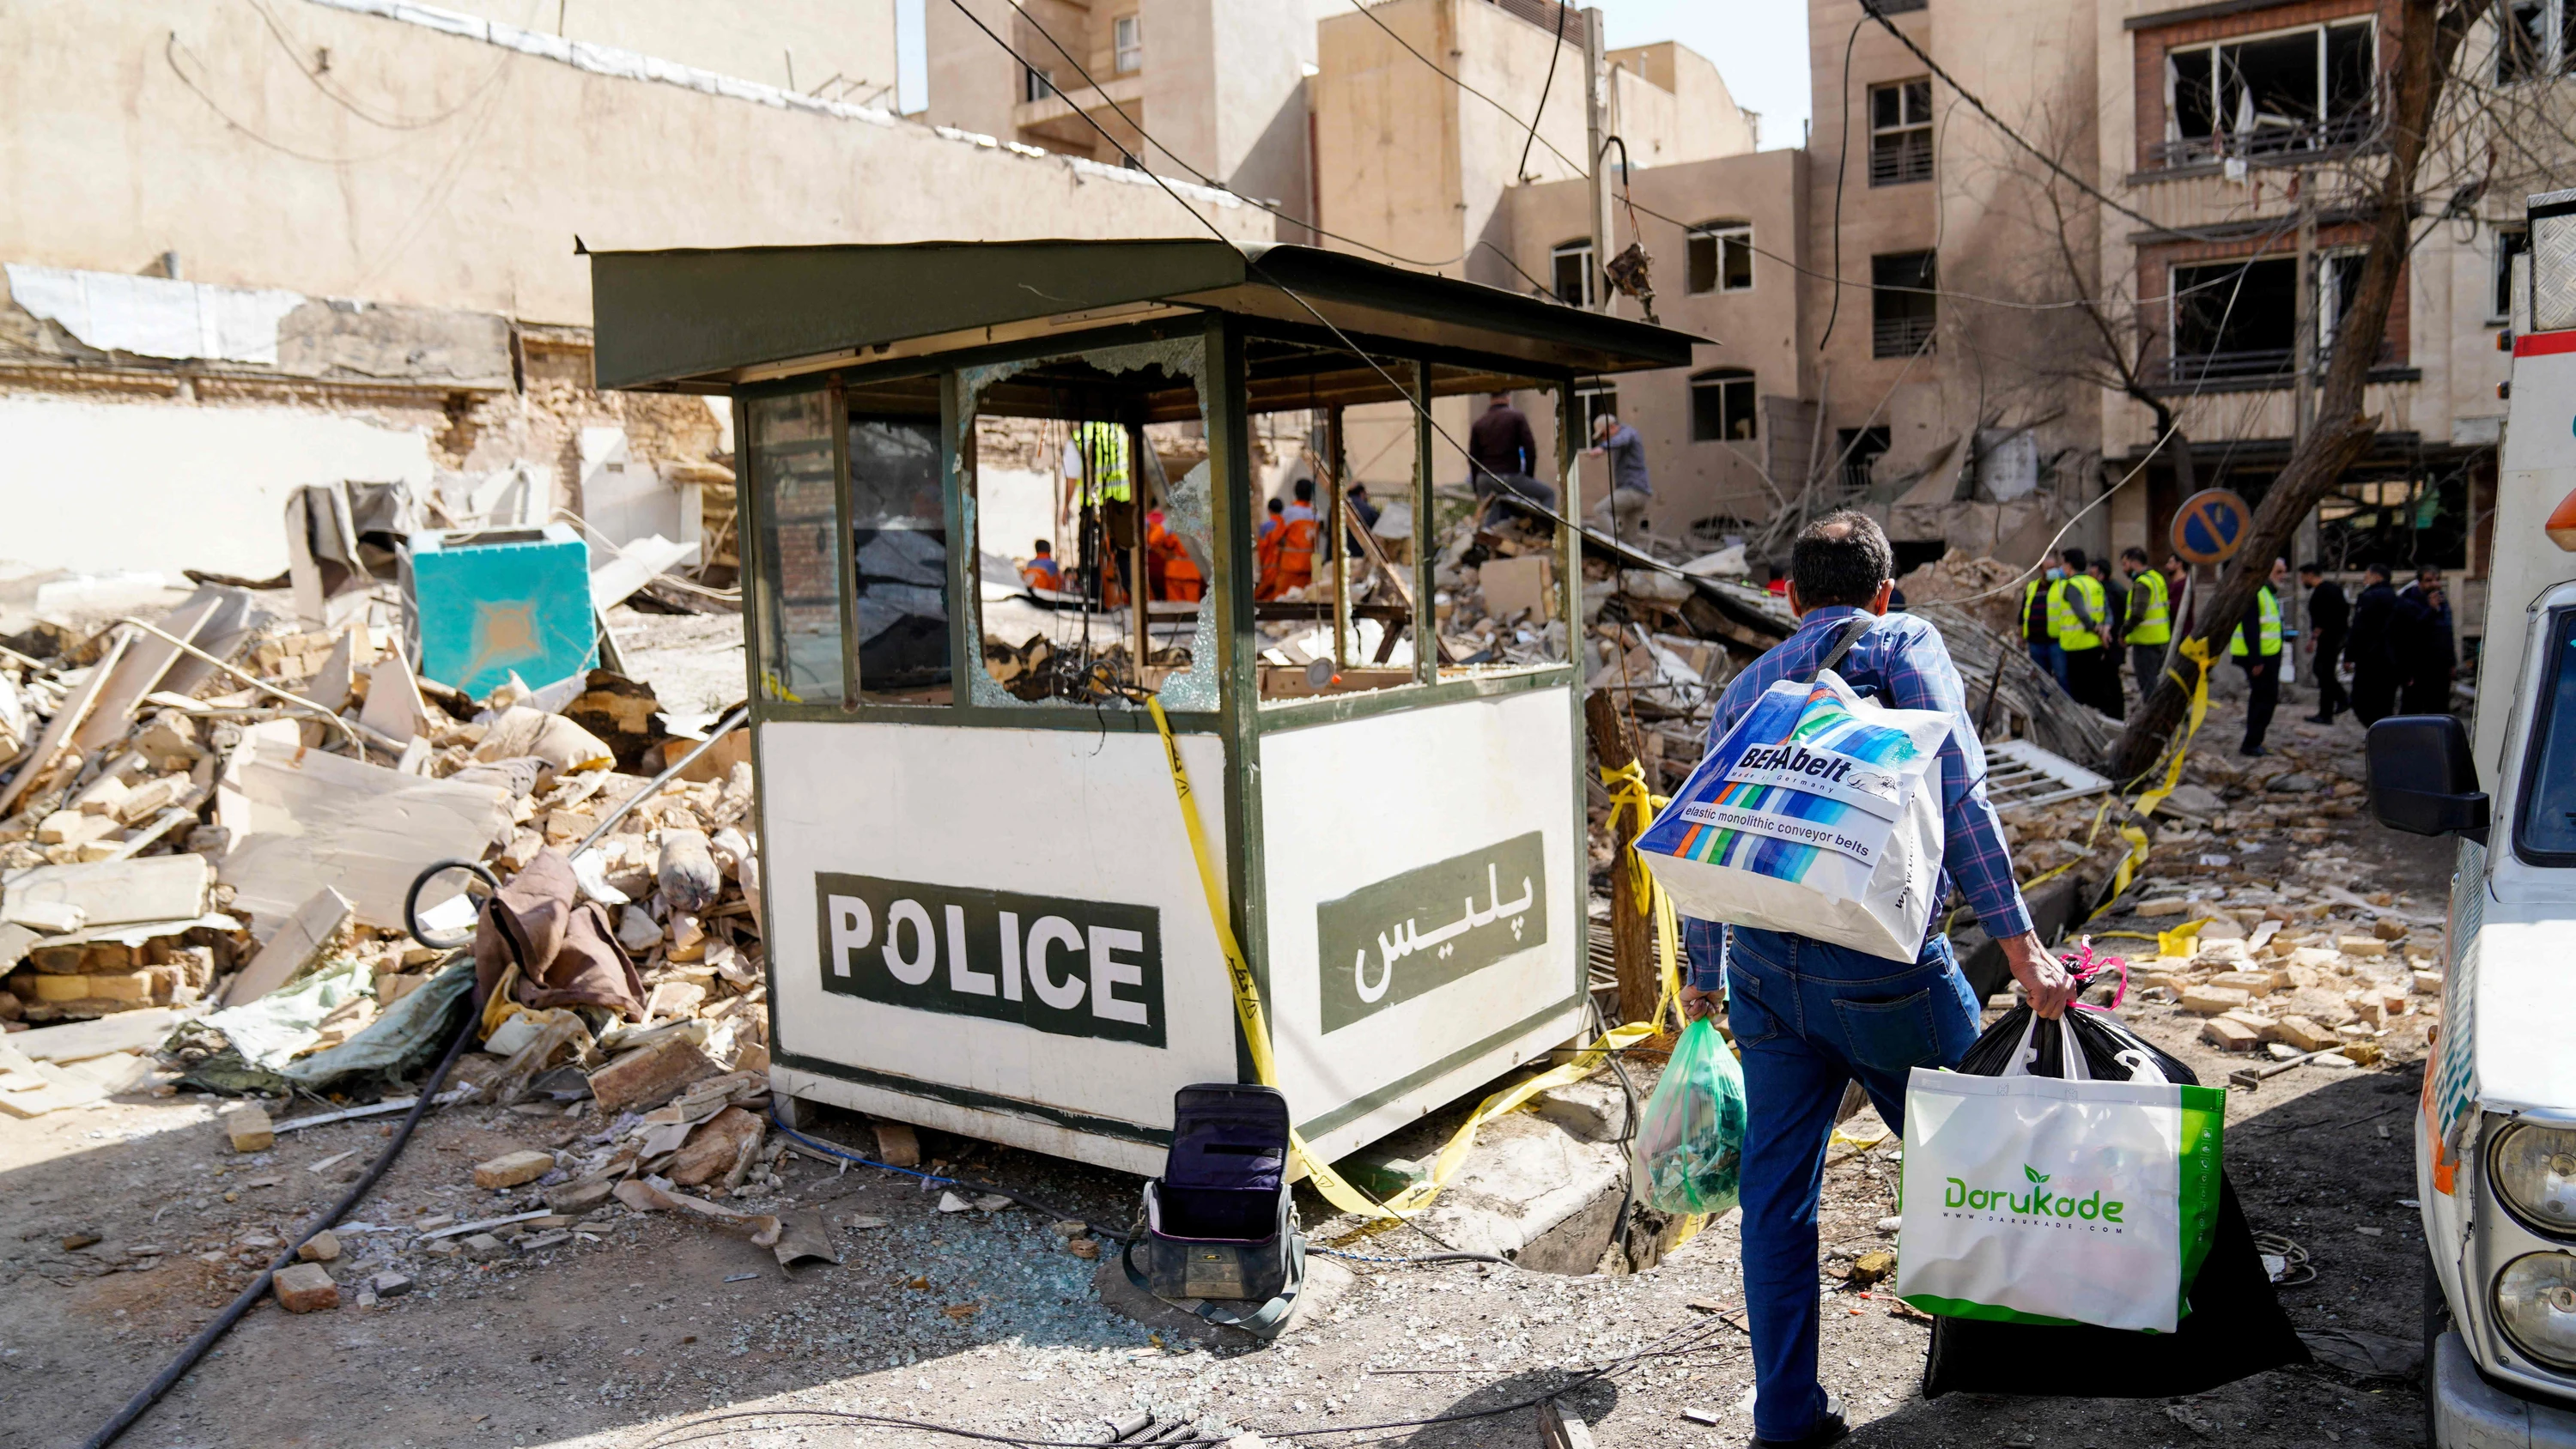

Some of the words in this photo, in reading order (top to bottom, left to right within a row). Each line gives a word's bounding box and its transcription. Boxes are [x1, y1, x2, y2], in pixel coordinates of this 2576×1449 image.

[1777, 774, 1834, 794] Germany
[1685, 806, 1716, 820] elastic
[1718, 812, 1774, 831] monolithic
[1777, 822, 1833, 842] conveyor
[1835, 834, 1869, 857] belts
[1354, 862, 1534, 1003] پلیس
[827, 893, 1149, 1026] POLICE
[1942, 1211, 2123, 1234] WWW.DARUKADE.COM
[1945, 1177, 2124, 1223] Darukade
